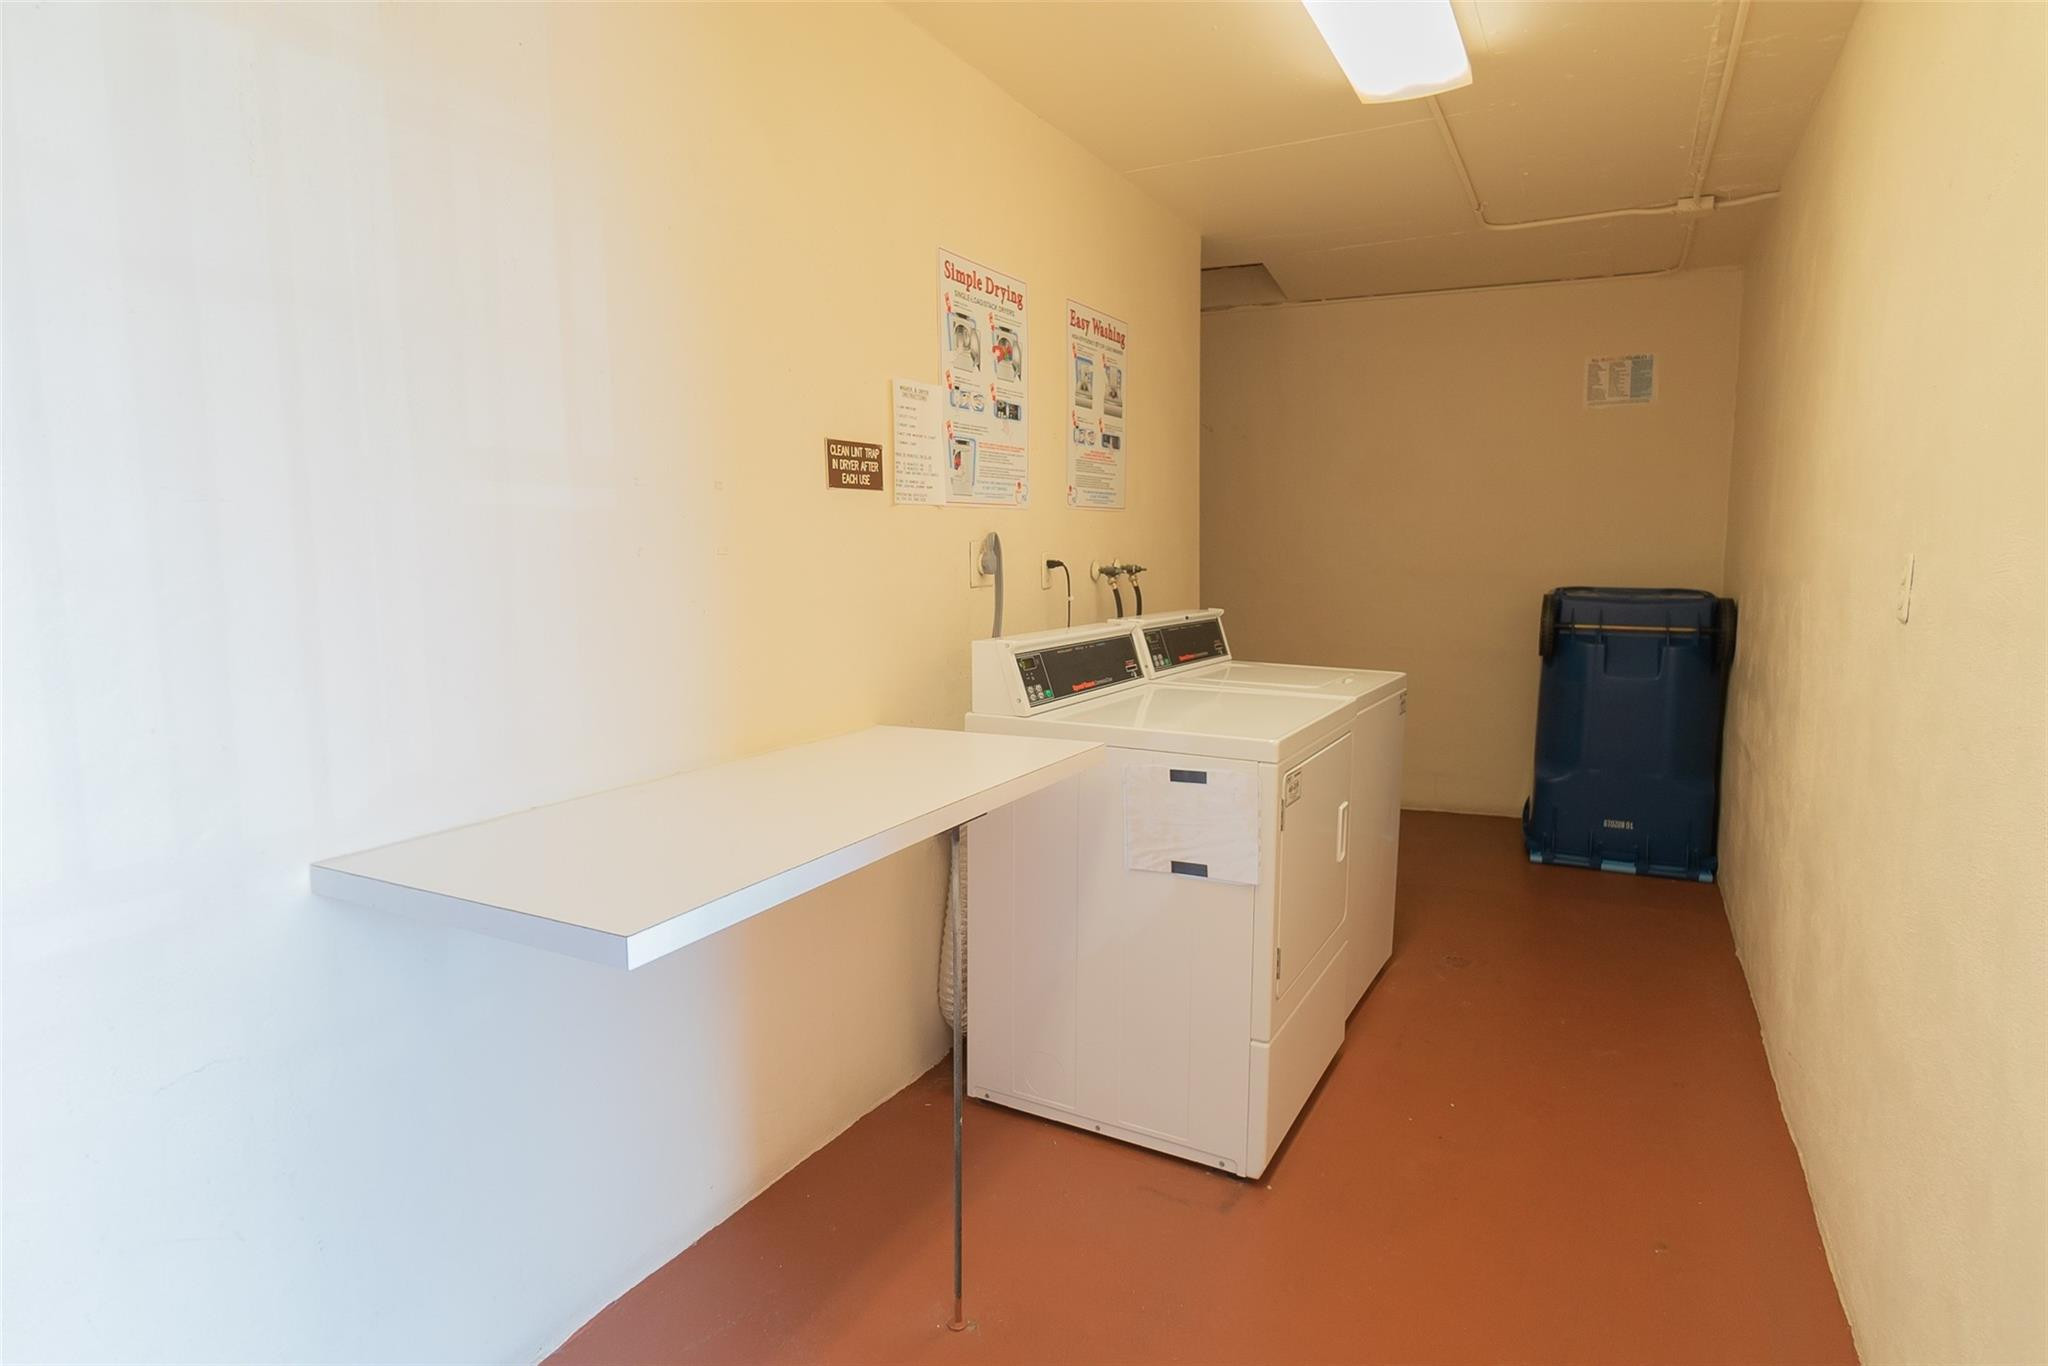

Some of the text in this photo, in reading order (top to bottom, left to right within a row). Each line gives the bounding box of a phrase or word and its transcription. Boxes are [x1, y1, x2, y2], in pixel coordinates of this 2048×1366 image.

[944, 260, 1023, 311] Simple Drying
[1070, 309, 1090, 336] Easy
[1092, 317, 1125, 350] Washing
[830, 444, 880, 459] CLEAN LINT TRAP
[832, 458, 879, 472] IN DRYER AFTER
[842, 473, 871, 486] EACH USE
